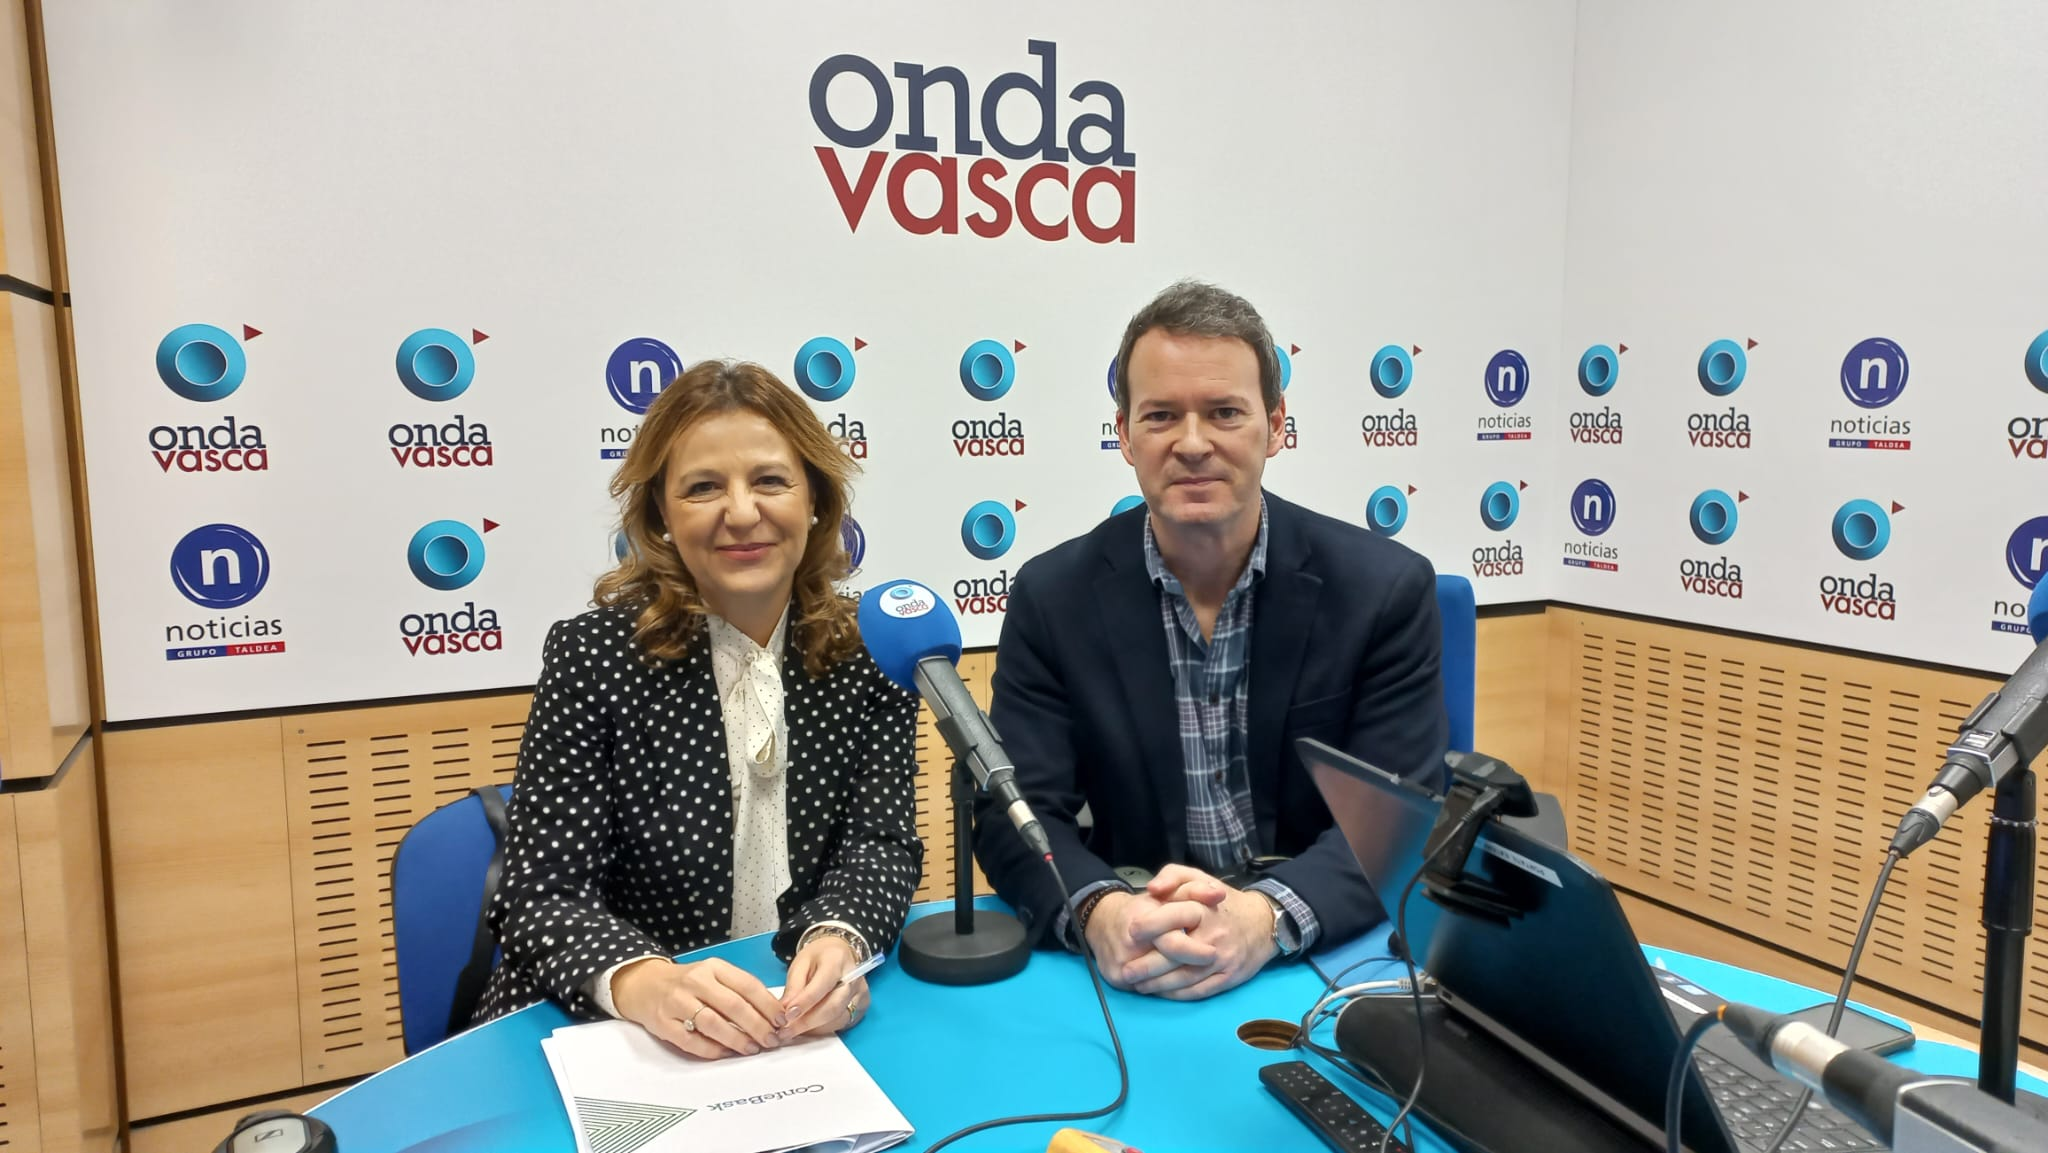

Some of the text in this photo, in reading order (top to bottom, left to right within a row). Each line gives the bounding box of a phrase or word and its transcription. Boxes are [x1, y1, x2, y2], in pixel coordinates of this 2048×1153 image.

[808, 39, 1136, 167] onda
[813, 146, 1135, 244] vasca
[827, 413, 867, 441] da
[951, 412, 1024, 439] onda
[1362, 408, 1417, 432] onda
[1478, 413, 1532, 429] noticias
[1569, 406, 1623, 429] onda
[1687, 407, 1751, 432] onda
[1831, 415, 1911, 435] noticias
[2008, 417, 2048, 438] on
[149, 416, 266, 450] onda
[388, 415, 492, 447] onda
[1362, 431, 1417, 447] vasca
[1570, 428, 1623, 444] vasca
[1688, 431, 1751, 448] vasca
[391, 445, 493, 468] vasca
[953, 438, 1025, 457] vasca
[1874, 441, 1905, 449] TALDEA
[152, 449, 268, 473] vasca
[1472, 540, 1523, 563] onda
[1564, 541, 1618, 560] noticias
[1472, 560, 1523, 578] vasca
[1680, 556, 1743, 582] onda
[953, 570, 1015, 598] ond
[1681, 576, 1743, 599] vasca
[1820, 573, 1896, 603] onda
[895, 599, 925, 613] onda
[955, 595, 1008, 616] vasc
[1820, 594, 1895, 621] vasca
[166, 615, 283, 642] noticias
[400, 602, 501, 637] onda
[177, 644, 278, 658] GRUPO TALDEA
[402, 630, 502, 657] vasca
[706, 1084, 825, 1111] ConfeBask
